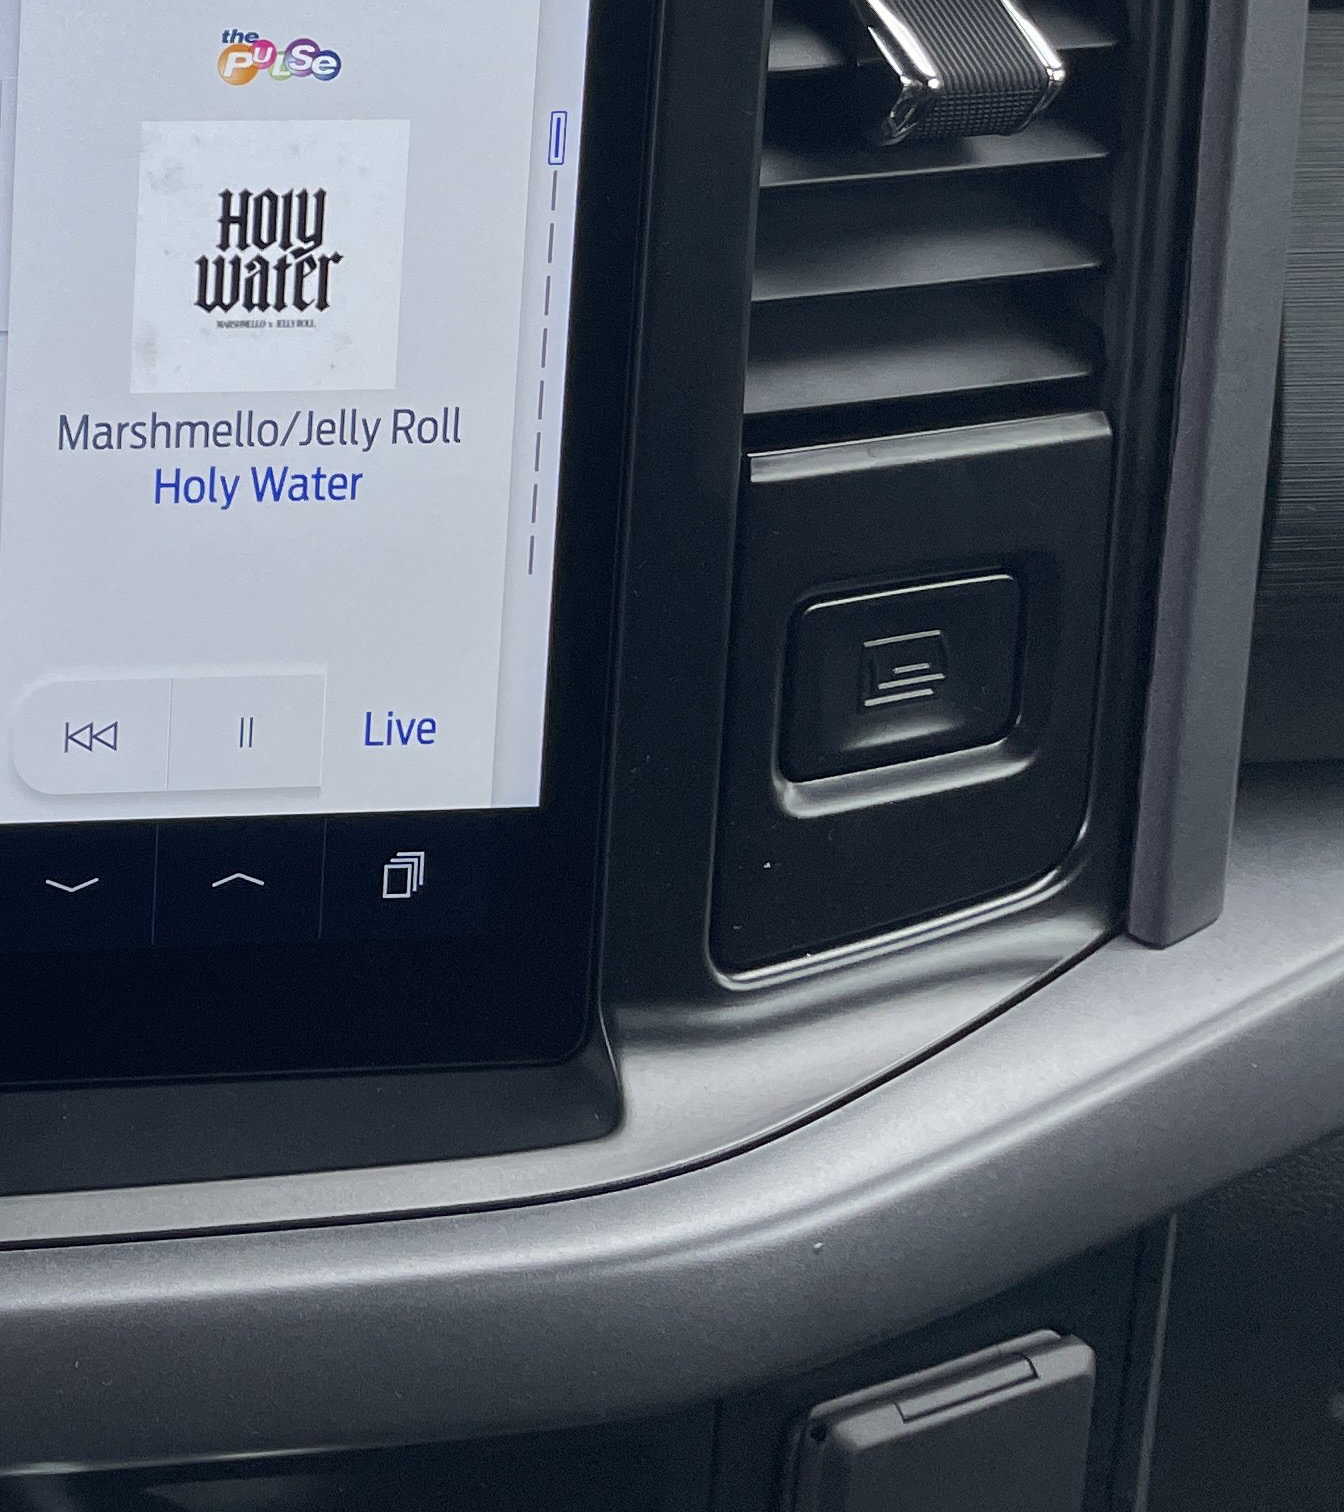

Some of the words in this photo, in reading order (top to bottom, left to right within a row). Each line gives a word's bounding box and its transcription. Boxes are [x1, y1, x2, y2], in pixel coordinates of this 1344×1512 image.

[222, 29, 259, 43] the
[59, 409, 381, 452] Marshmello/Jelly
[392, 407, 460, 444] Roll
[155, 466, 240, 510] Holy
[251, 467, 363, 502] Water
[365, 711, 436, 746] Live
